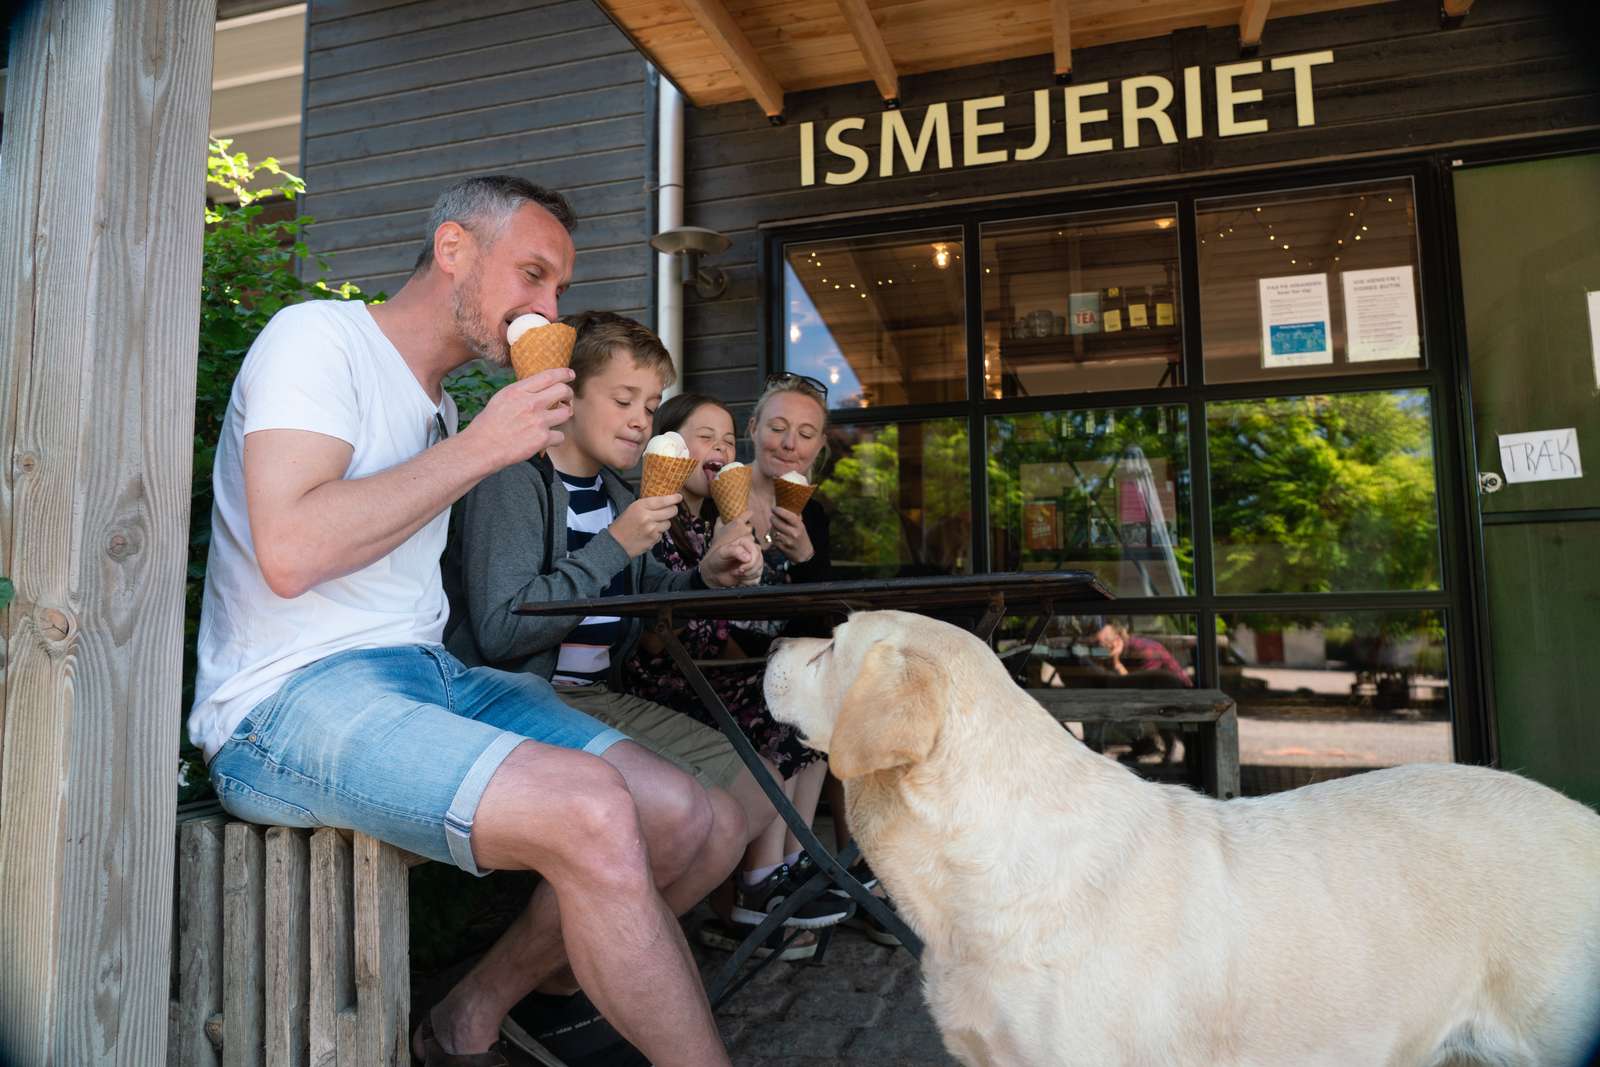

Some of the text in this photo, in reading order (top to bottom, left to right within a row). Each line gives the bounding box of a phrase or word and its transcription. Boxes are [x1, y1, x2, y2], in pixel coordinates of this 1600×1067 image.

[800, 50, 1334, 186] ISMEJERIET
[1075, 311, 1096, 325] TEA
[1500, 432, 1577, 475] TRÆK
